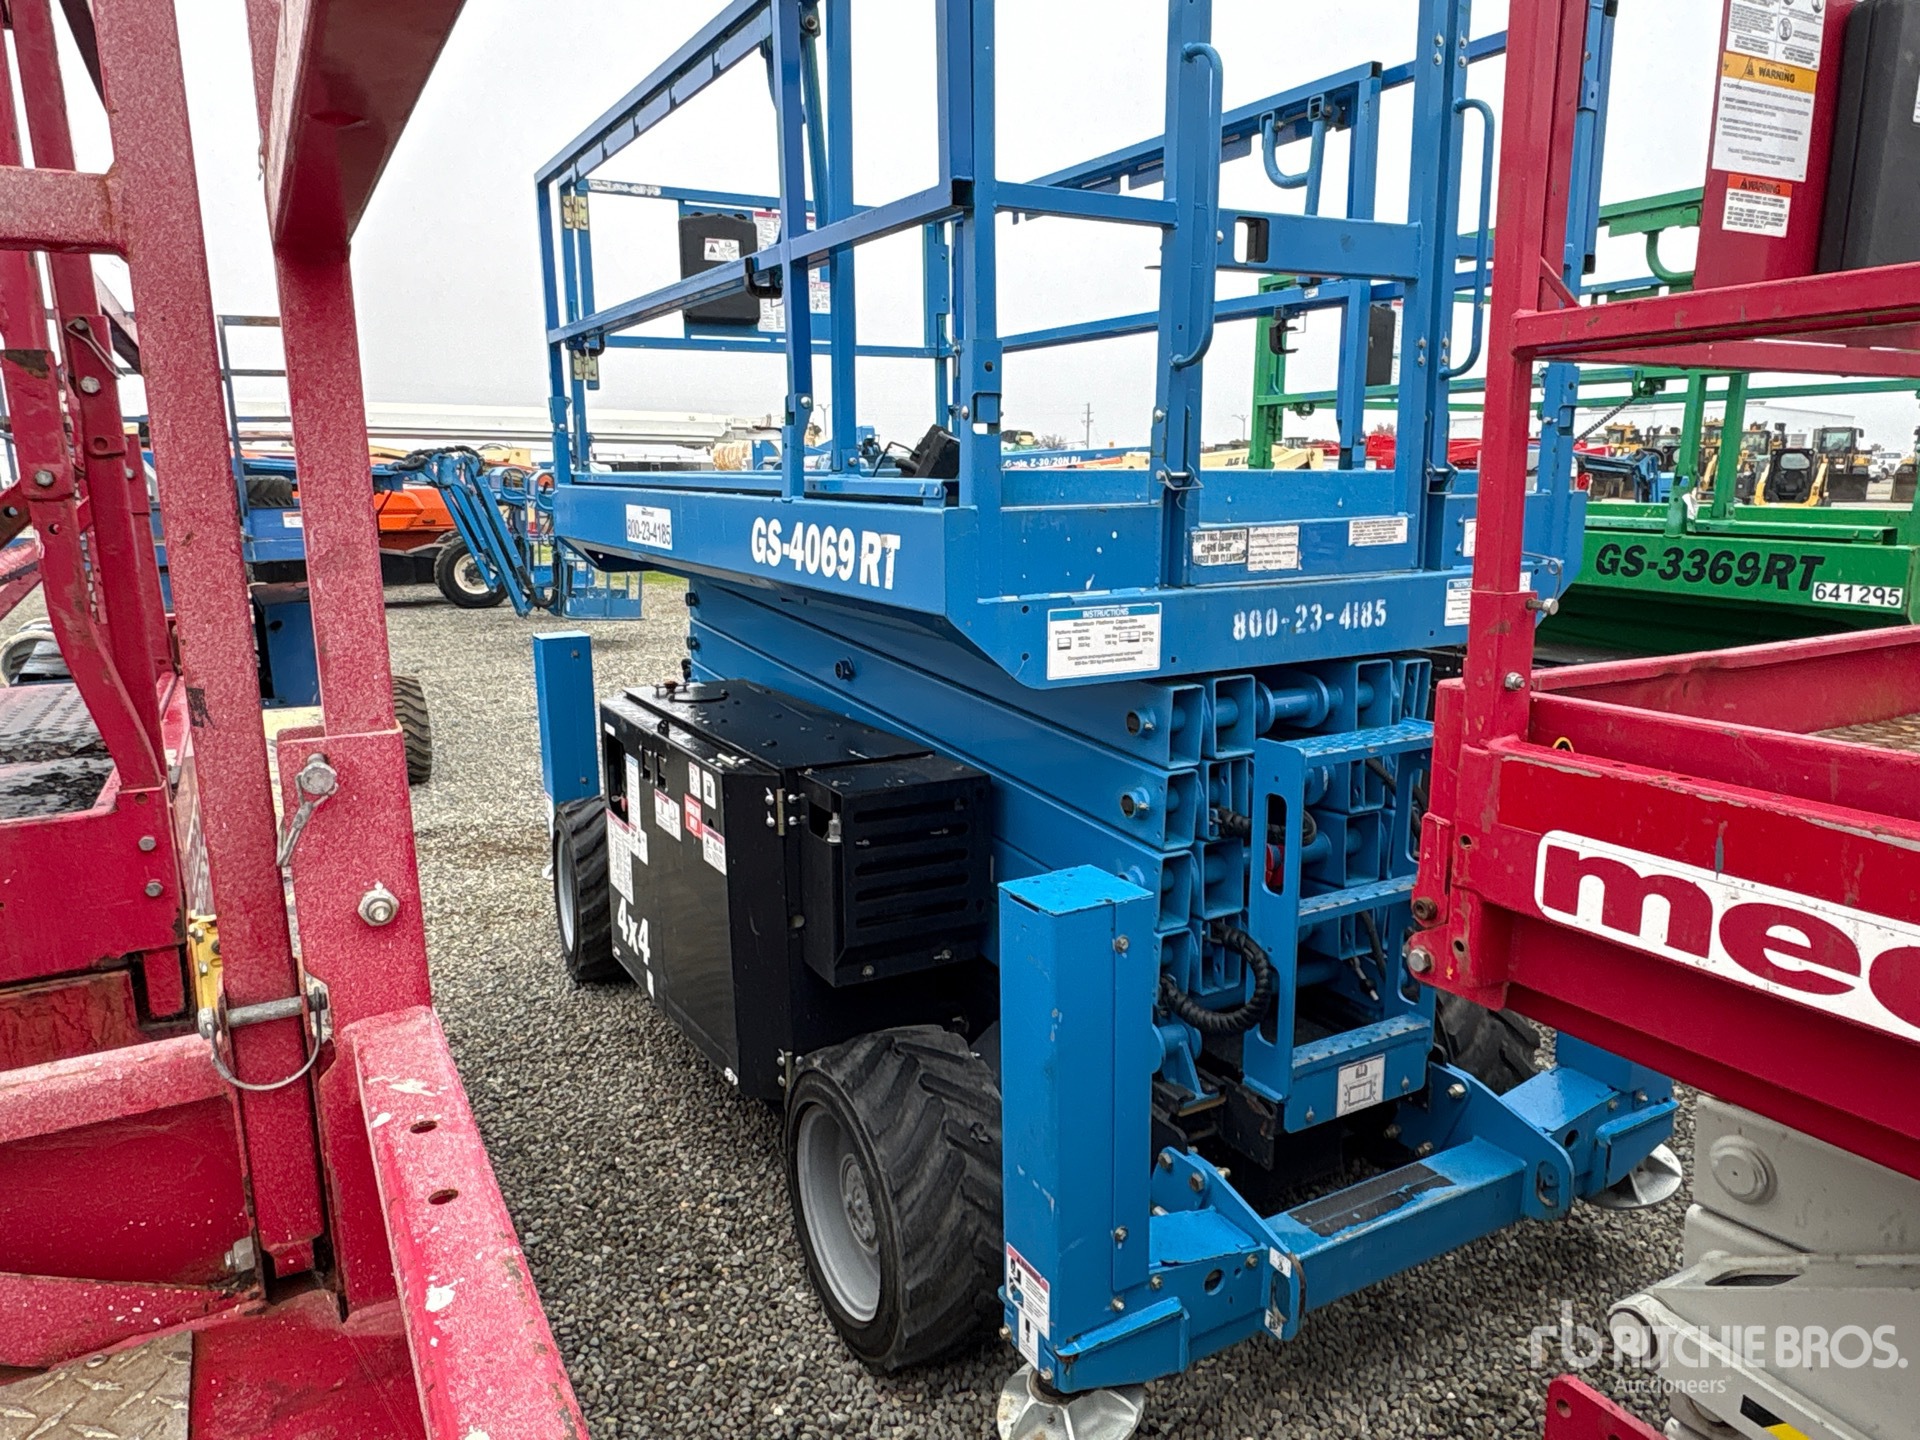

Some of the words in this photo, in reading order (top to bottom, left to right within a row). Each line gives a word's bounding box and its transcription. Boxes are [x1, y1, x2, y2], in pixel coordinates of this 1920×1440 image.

[1758, 66, 1796, 84] WARNING
[1225, 457, 1240, 466] JLG
[751, 516, 856, 582] GS-4069
[859, 530, 901, 590] RT
[1596, 543, 1825, 592] GS-3369RT
[1814, 583, 1901, 607] 641295
[1082, 608, 1130, 618] INSTRUCTIONS
[1233, 599, 1387, 640] 800-23-4185
[617, 896, 651, 966] 4x4
